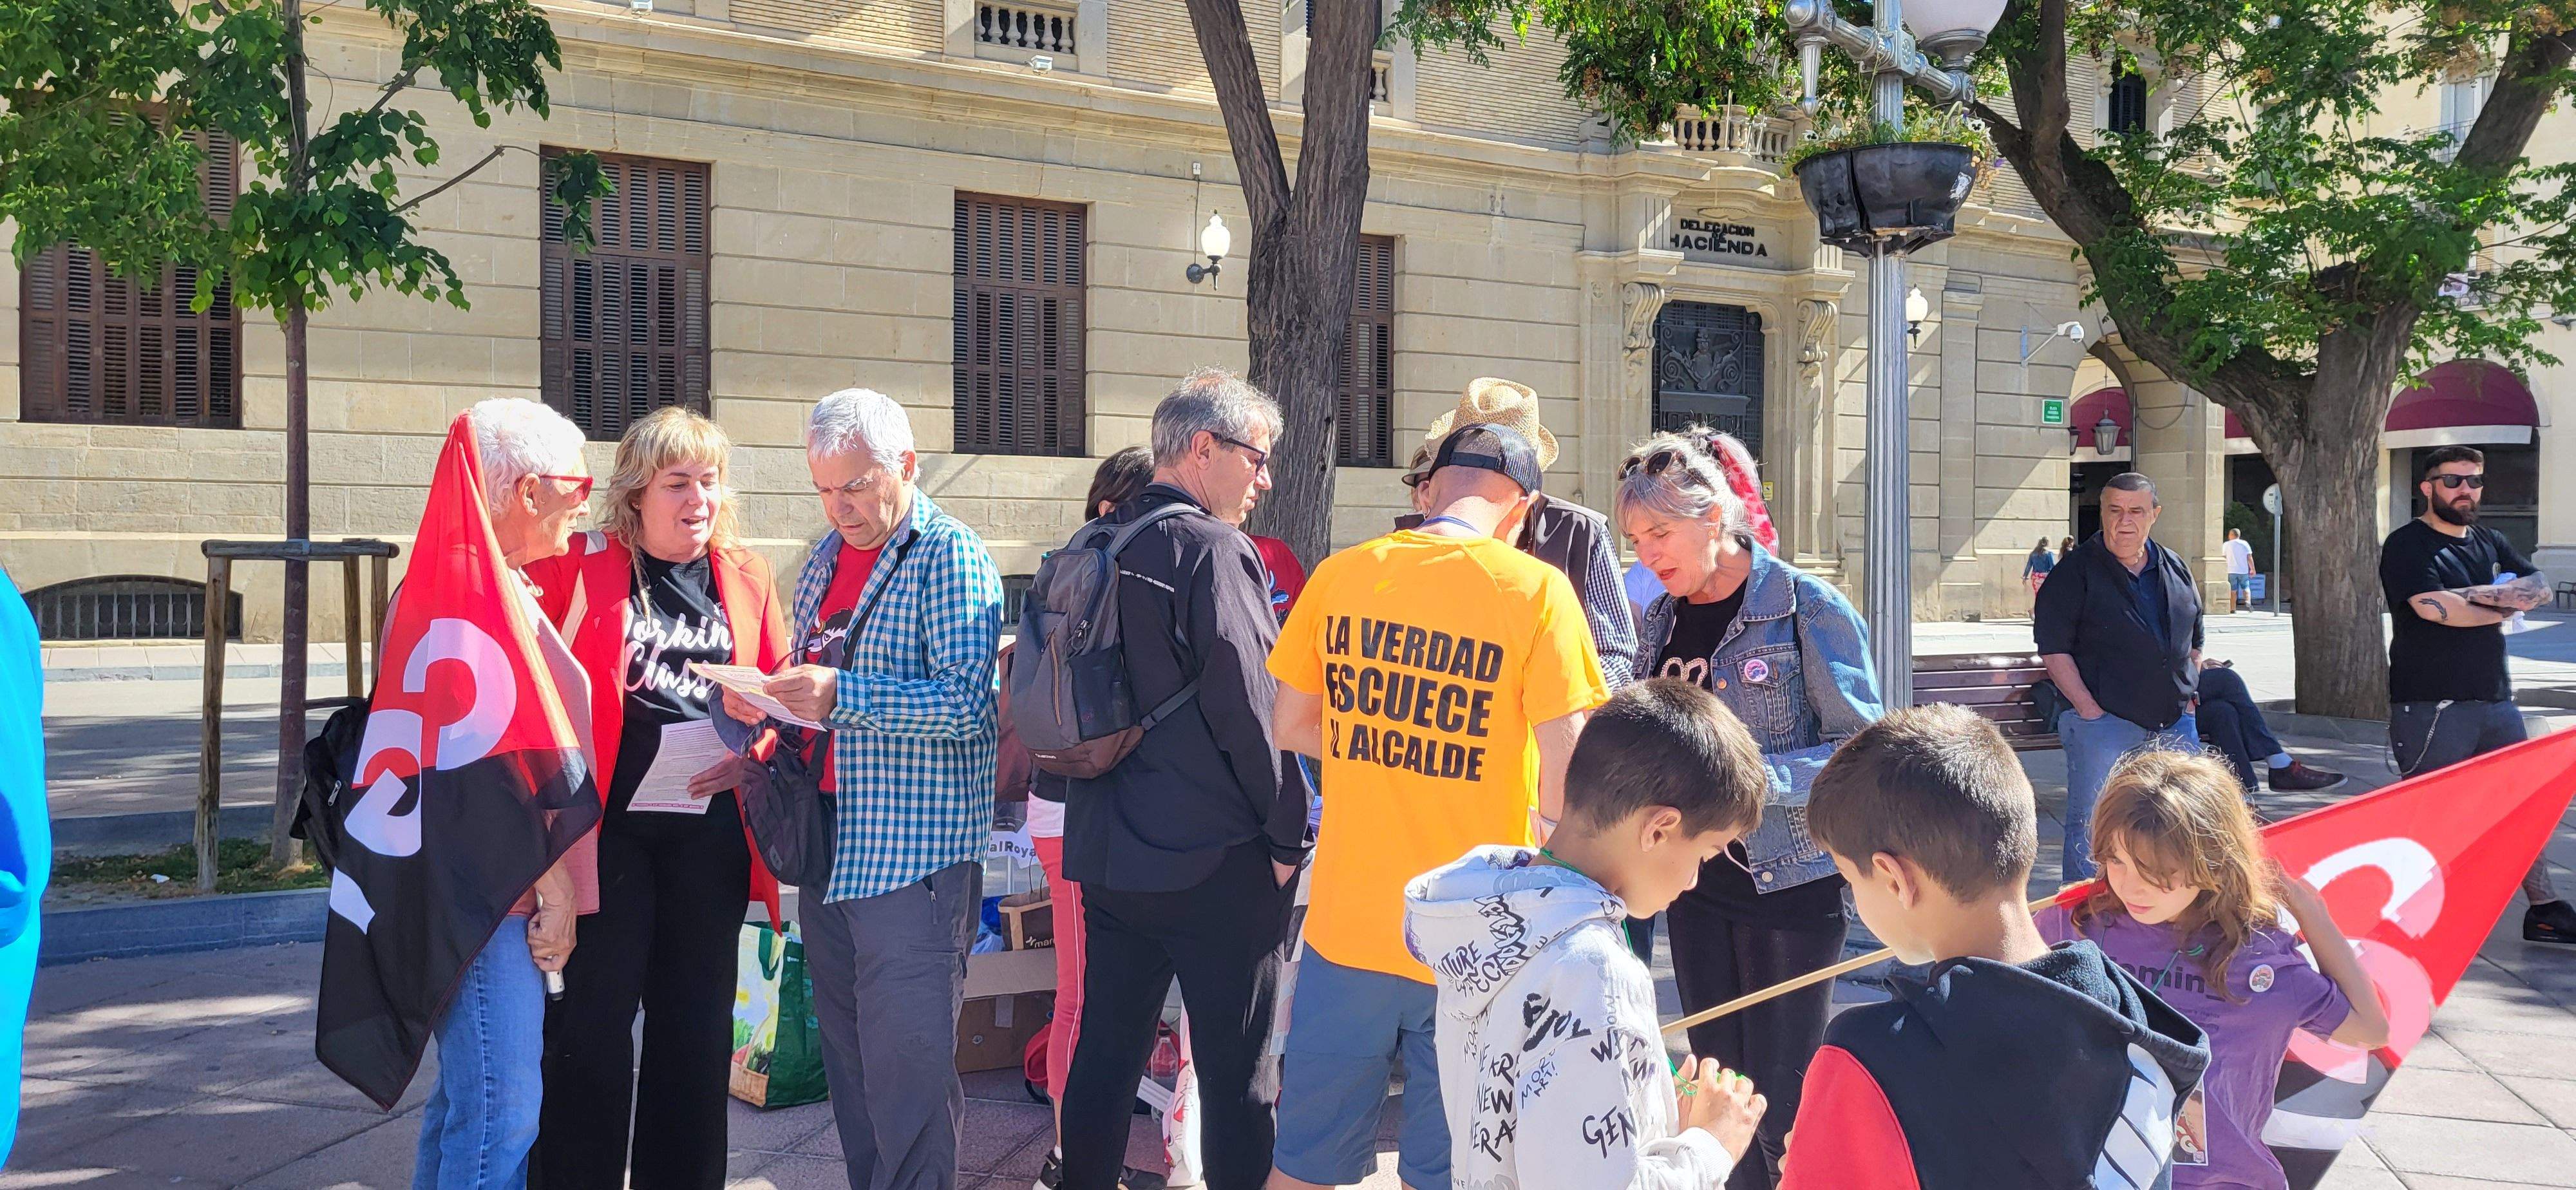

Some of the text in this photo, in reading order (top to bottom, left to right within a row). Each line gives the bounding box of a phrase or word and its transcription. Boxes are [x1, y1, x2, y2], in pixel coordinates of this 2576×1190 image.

[1670, 233, 1768, 257] HACIENDA
[1680, 218, 1755, 237] DELEGACION
[625, 603, 733, 650] orkin
[1325, 616, 1504, 683] LA VERDAD
[1325, 663, 1494, 738] ESCUECE
[1347, 724, 1486, 782] ALCALDE
